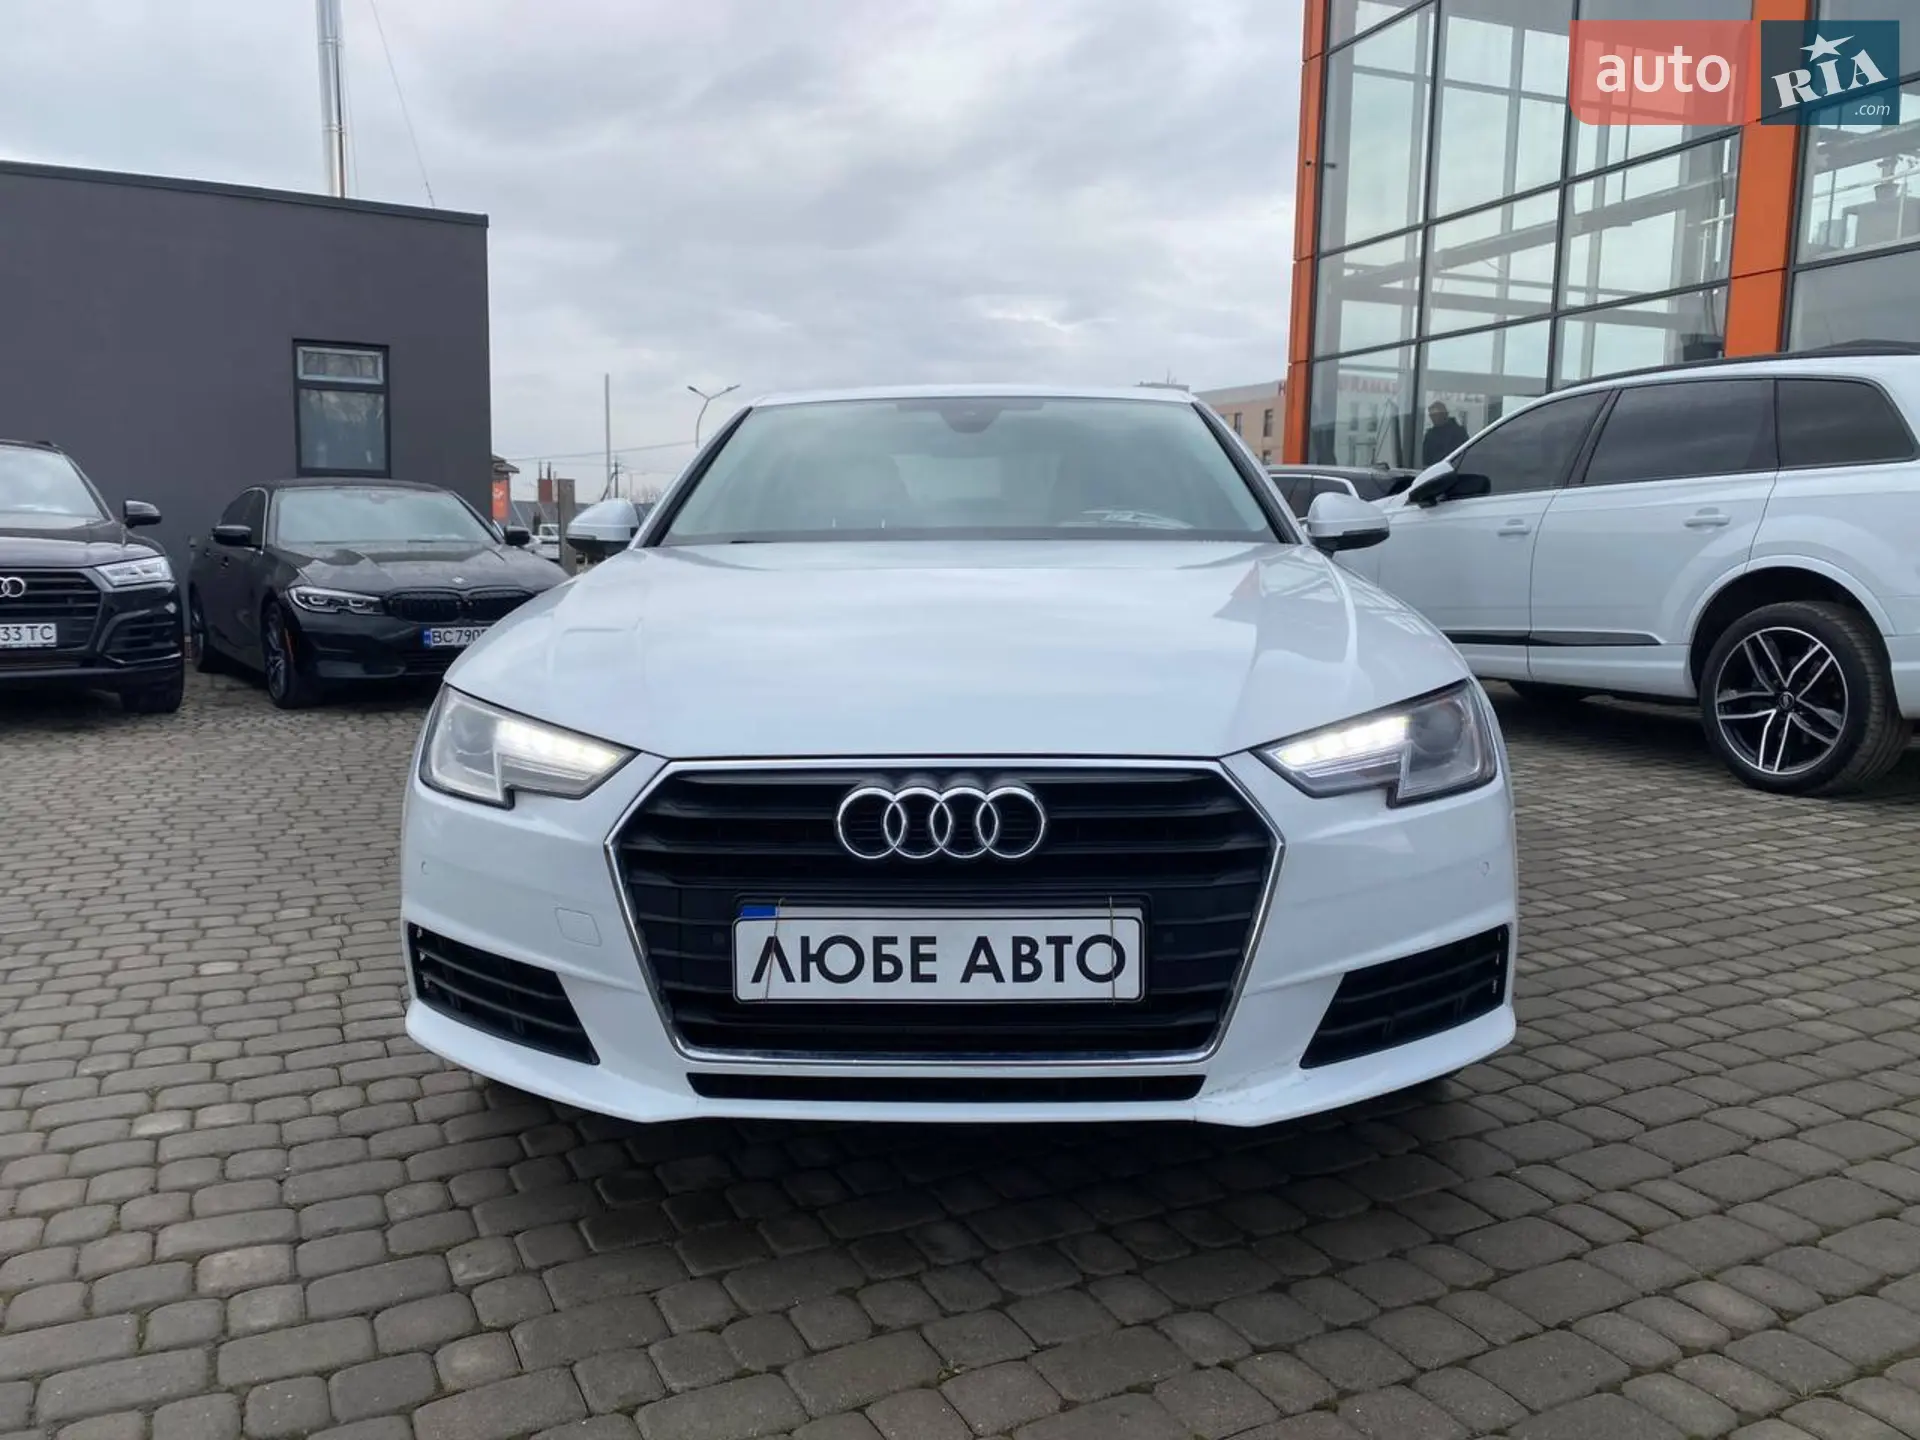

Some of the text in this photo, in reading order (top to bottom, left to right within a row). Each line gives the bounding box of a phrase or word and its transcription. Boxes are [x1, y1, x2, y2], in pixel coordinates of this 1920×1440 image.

[456, 629, 487, 642] 790
[751, 934, 1126, 984] ЛЮБЕ АВТО
